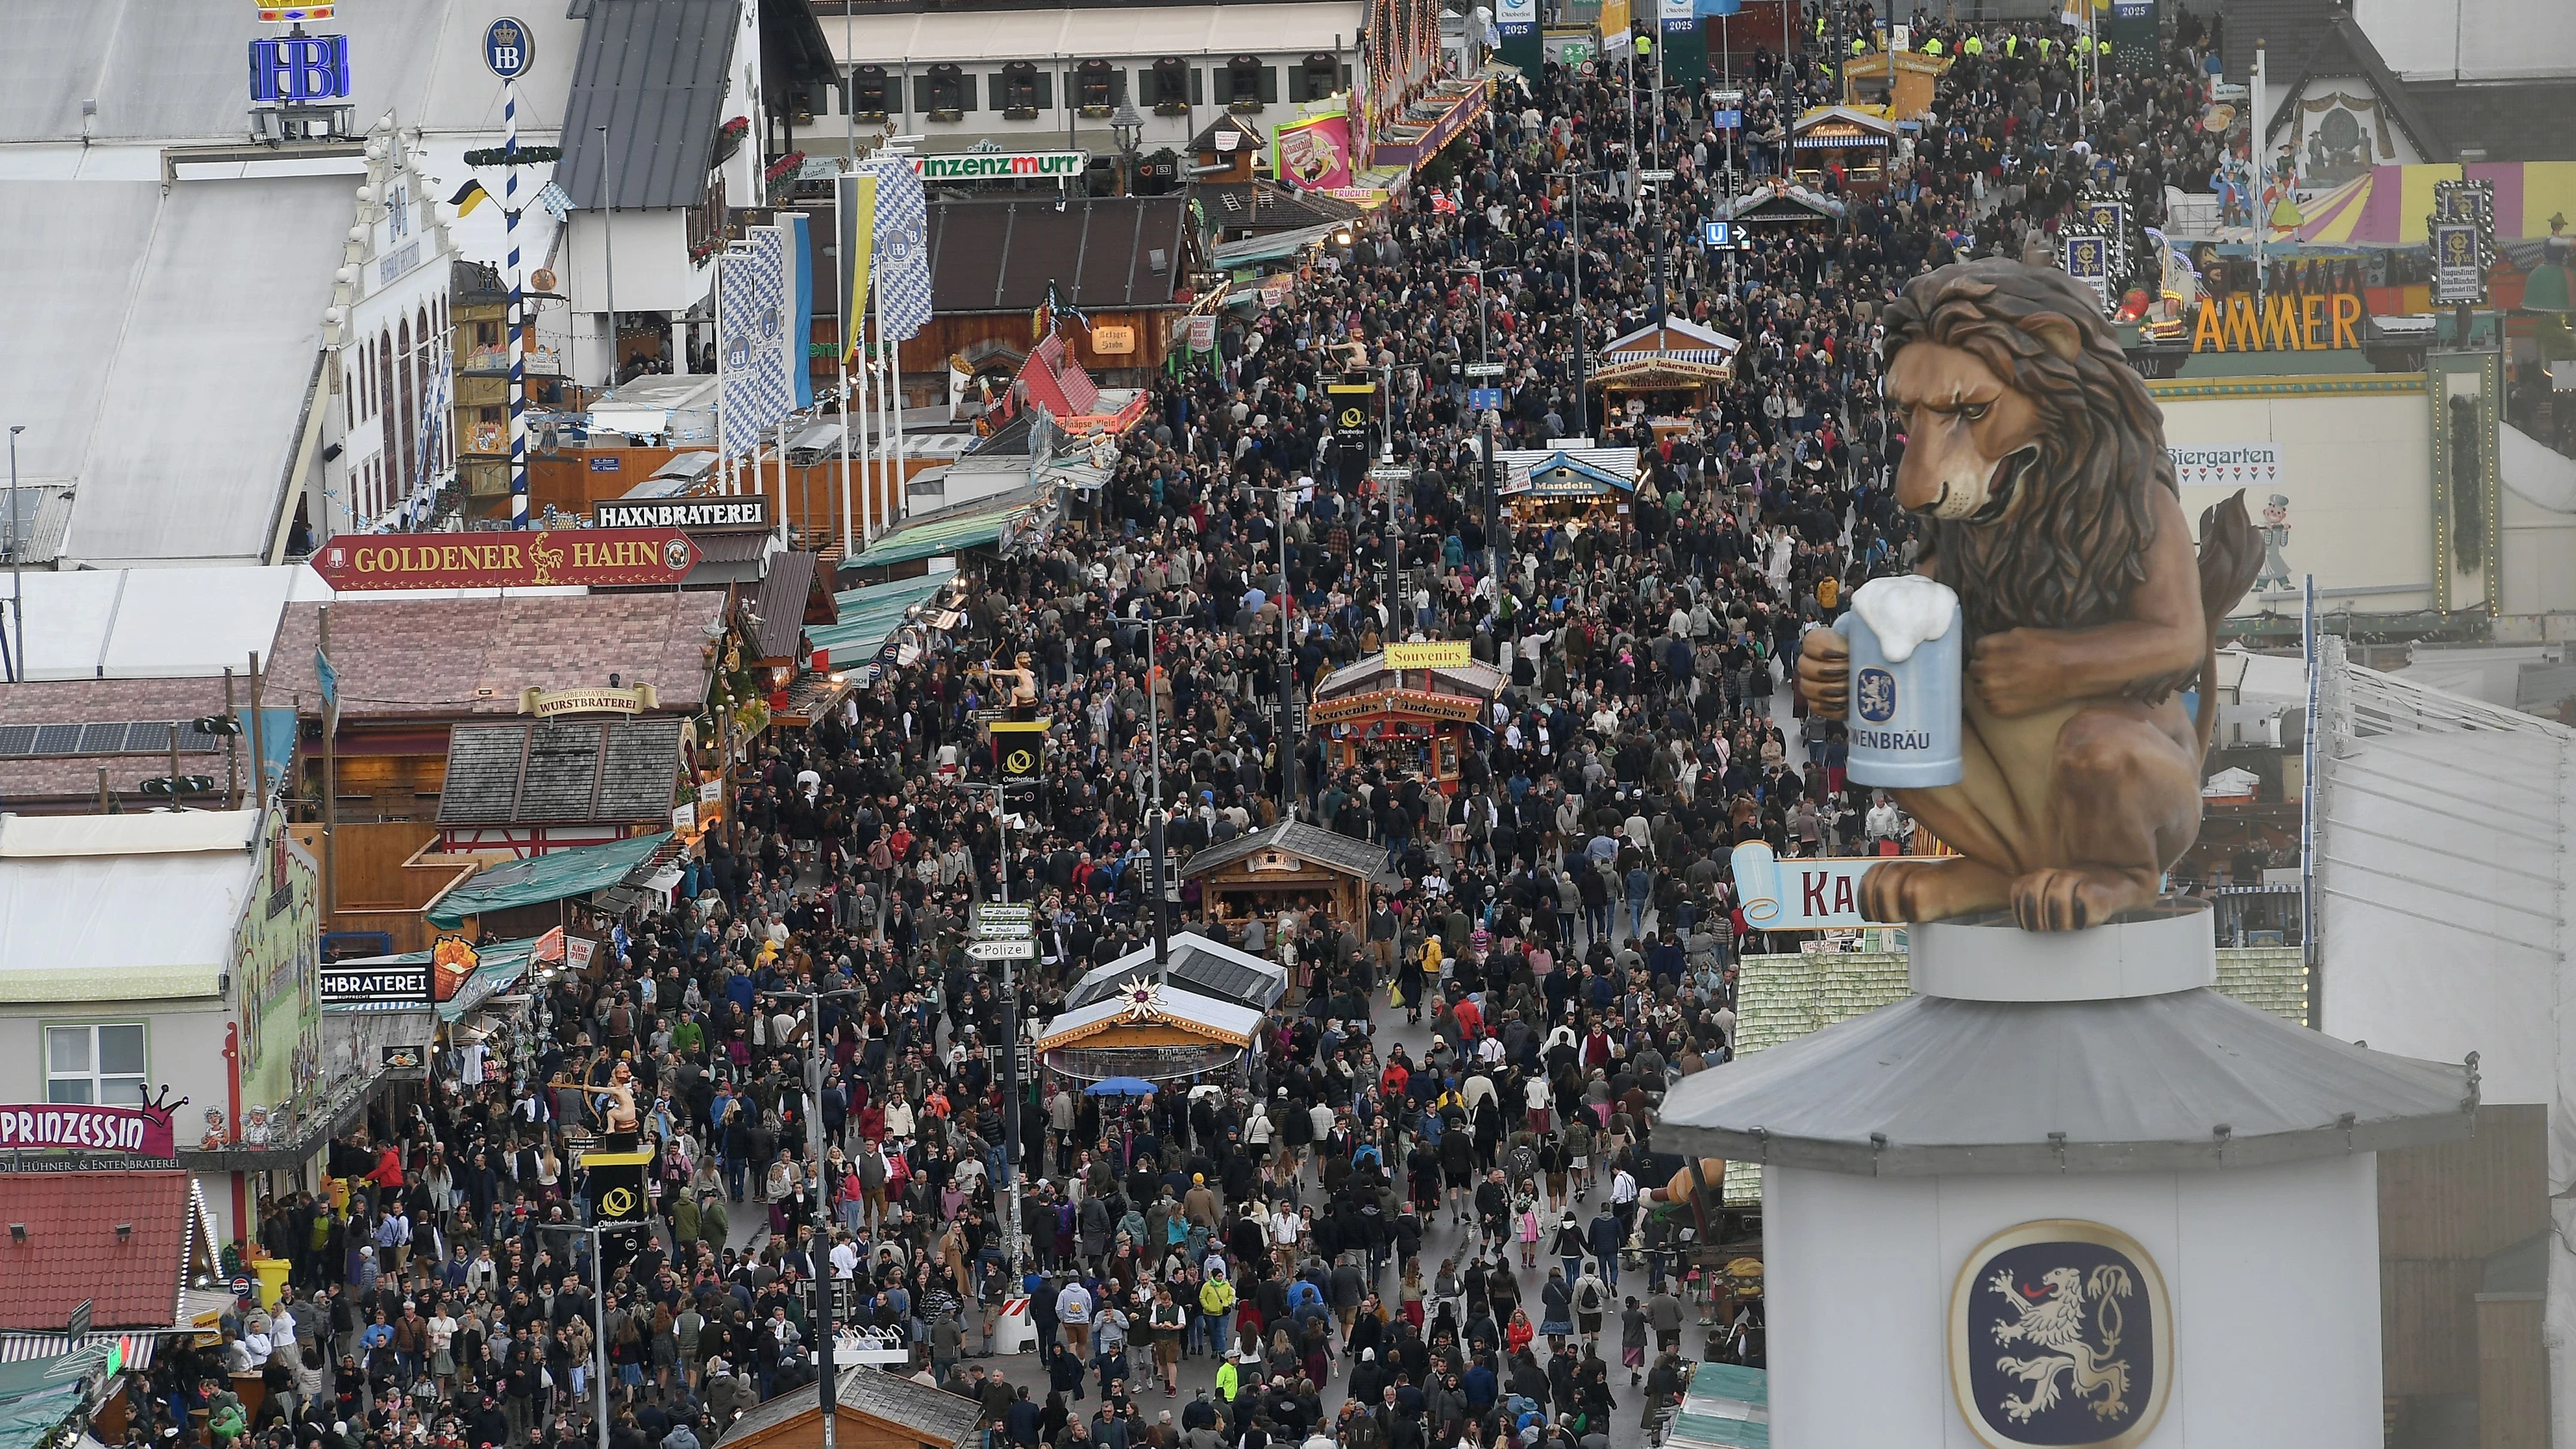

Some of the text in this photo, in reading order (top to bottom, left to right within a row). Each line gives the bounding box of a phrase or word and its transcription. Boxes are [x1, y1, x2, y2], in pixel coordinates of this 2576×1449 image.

[2123, 7, 2146, 16] 2025
[1504, 24, 1528, 34] 2025
[1668, 20, 1693, 31] 2025
[494, 46, 519, 70] HB
[254, 39, 336, 101] HB
[1848, 64, 1877, 75] Souvenirs
[1904, 62, 1940, 73] Information
[1813, 125, 1858, 137] Mandeln
[1282, 137, 1314, 156] Schaschlik
[1334, 186, 1371, 198] FRÜCHTE
[1710, 225, 1723, 241] U
[892, 243, 905, 256] HB
[2453, 276, 2477, 285] München
[2192, 292, 2361, 353] AMMER
[1098, 332, 1127, 341] Metzger
[1593, 360, 1728, 380] enbrot Erdnüsse Zuckerwatte Popcorn
[2166, 447, 2275, 468] Biergarten
[1534, 481, 1592, 490] Mandeln
[599, 503, 762, 528] HAXNBRATEREI
[354, 545, 523, 574] GOLDENER
[572, 540, 659, 569] HAHN
[1394, 649, 1461, 663] Souvenirs
[539, 697, 637, 713] WURSTBRATEREI
[1315, 701, 1467, 721] Souvenirs Andenken
[1801, 871, 1856, 916] KA
[985, 943, 1026, 956] Polizei
[21, 1160, 76, 1172] HÜHNER-
[79, 1160, 88, 1170] &
[92, 1159, 179, 1171] ENTENBRATEREI
